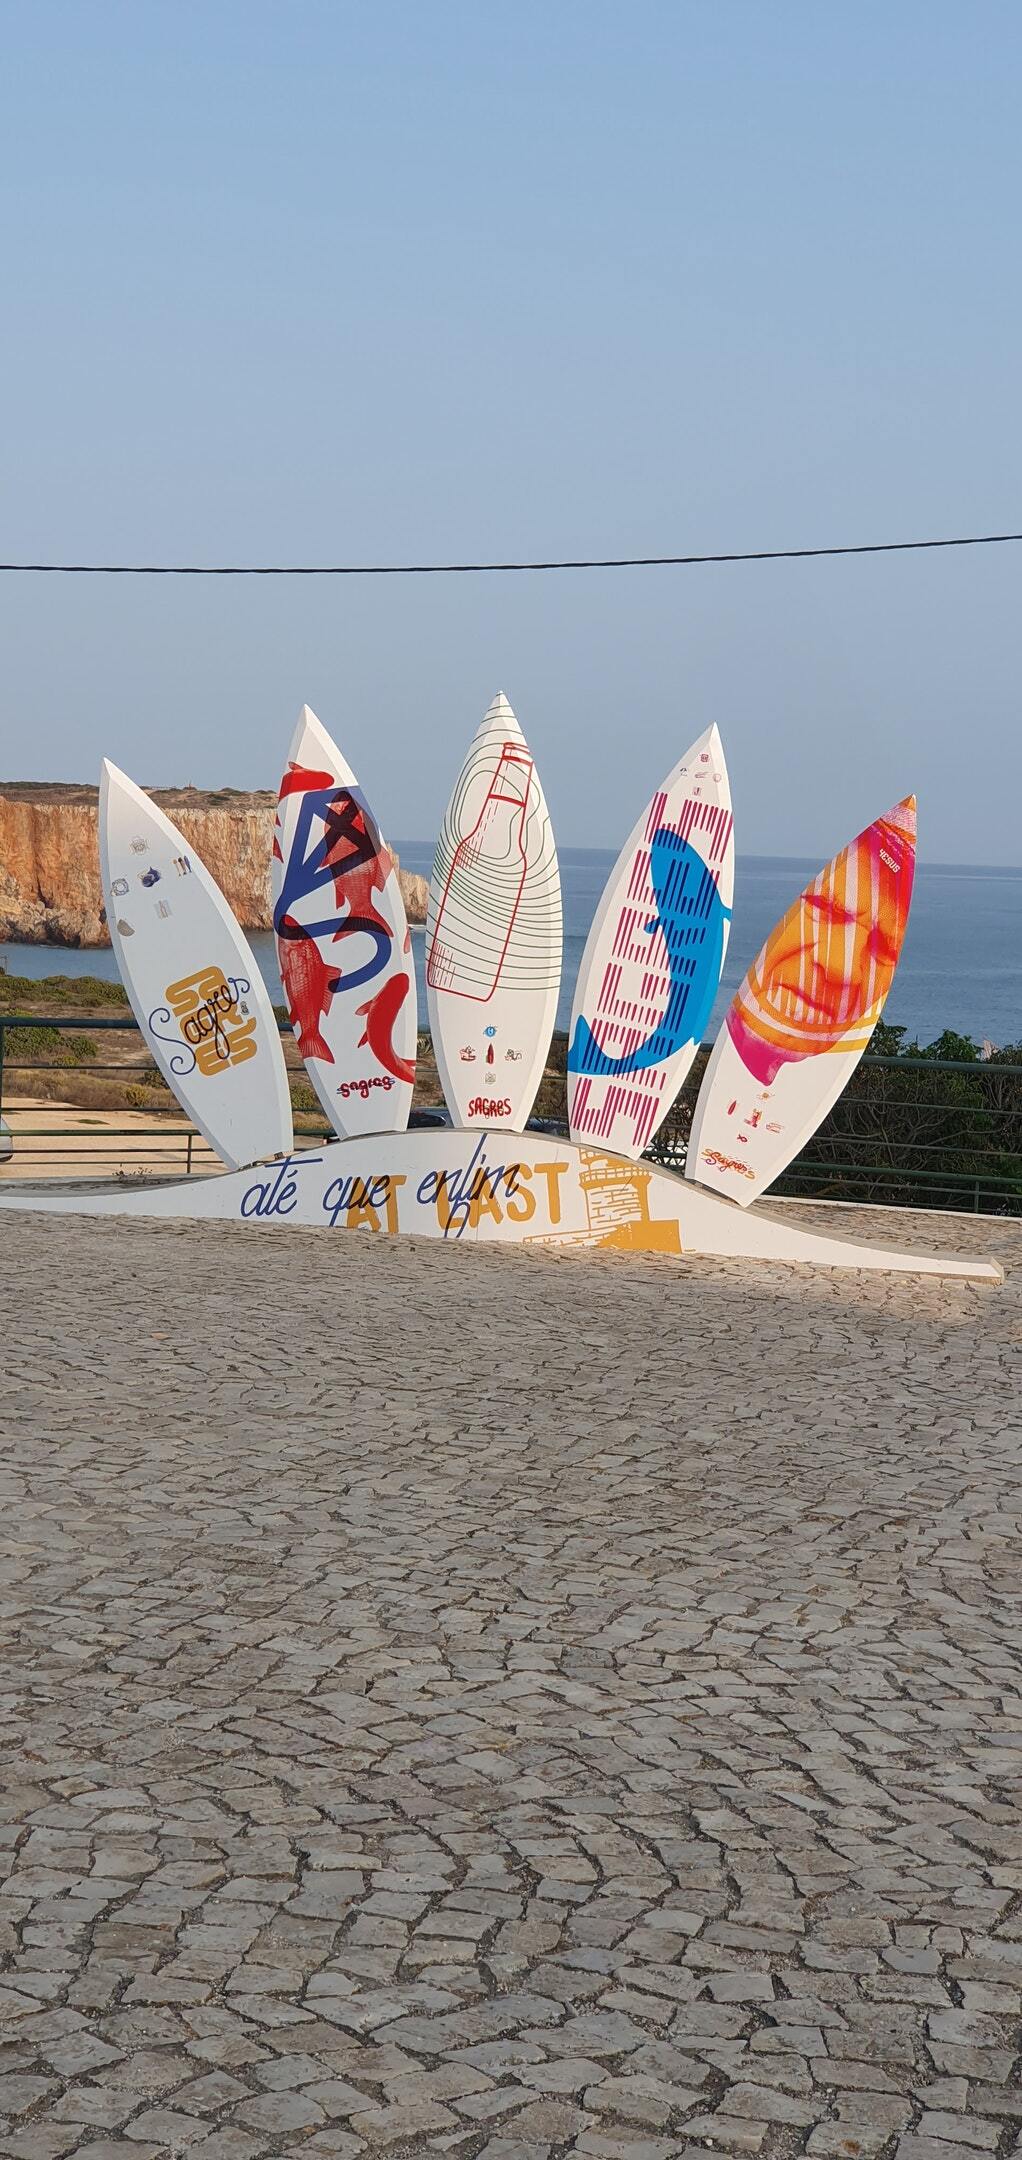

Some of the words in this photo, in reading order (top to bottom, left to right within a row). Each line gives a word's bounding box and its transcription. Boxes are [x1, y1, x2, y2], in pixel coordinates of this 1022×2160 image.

[241, 1157, 323, 1217] até
[323, 1175, 391, 1227] que
[346, 1175, 407, 1234] AT
[436, 1162, 569, 1229] LAST
